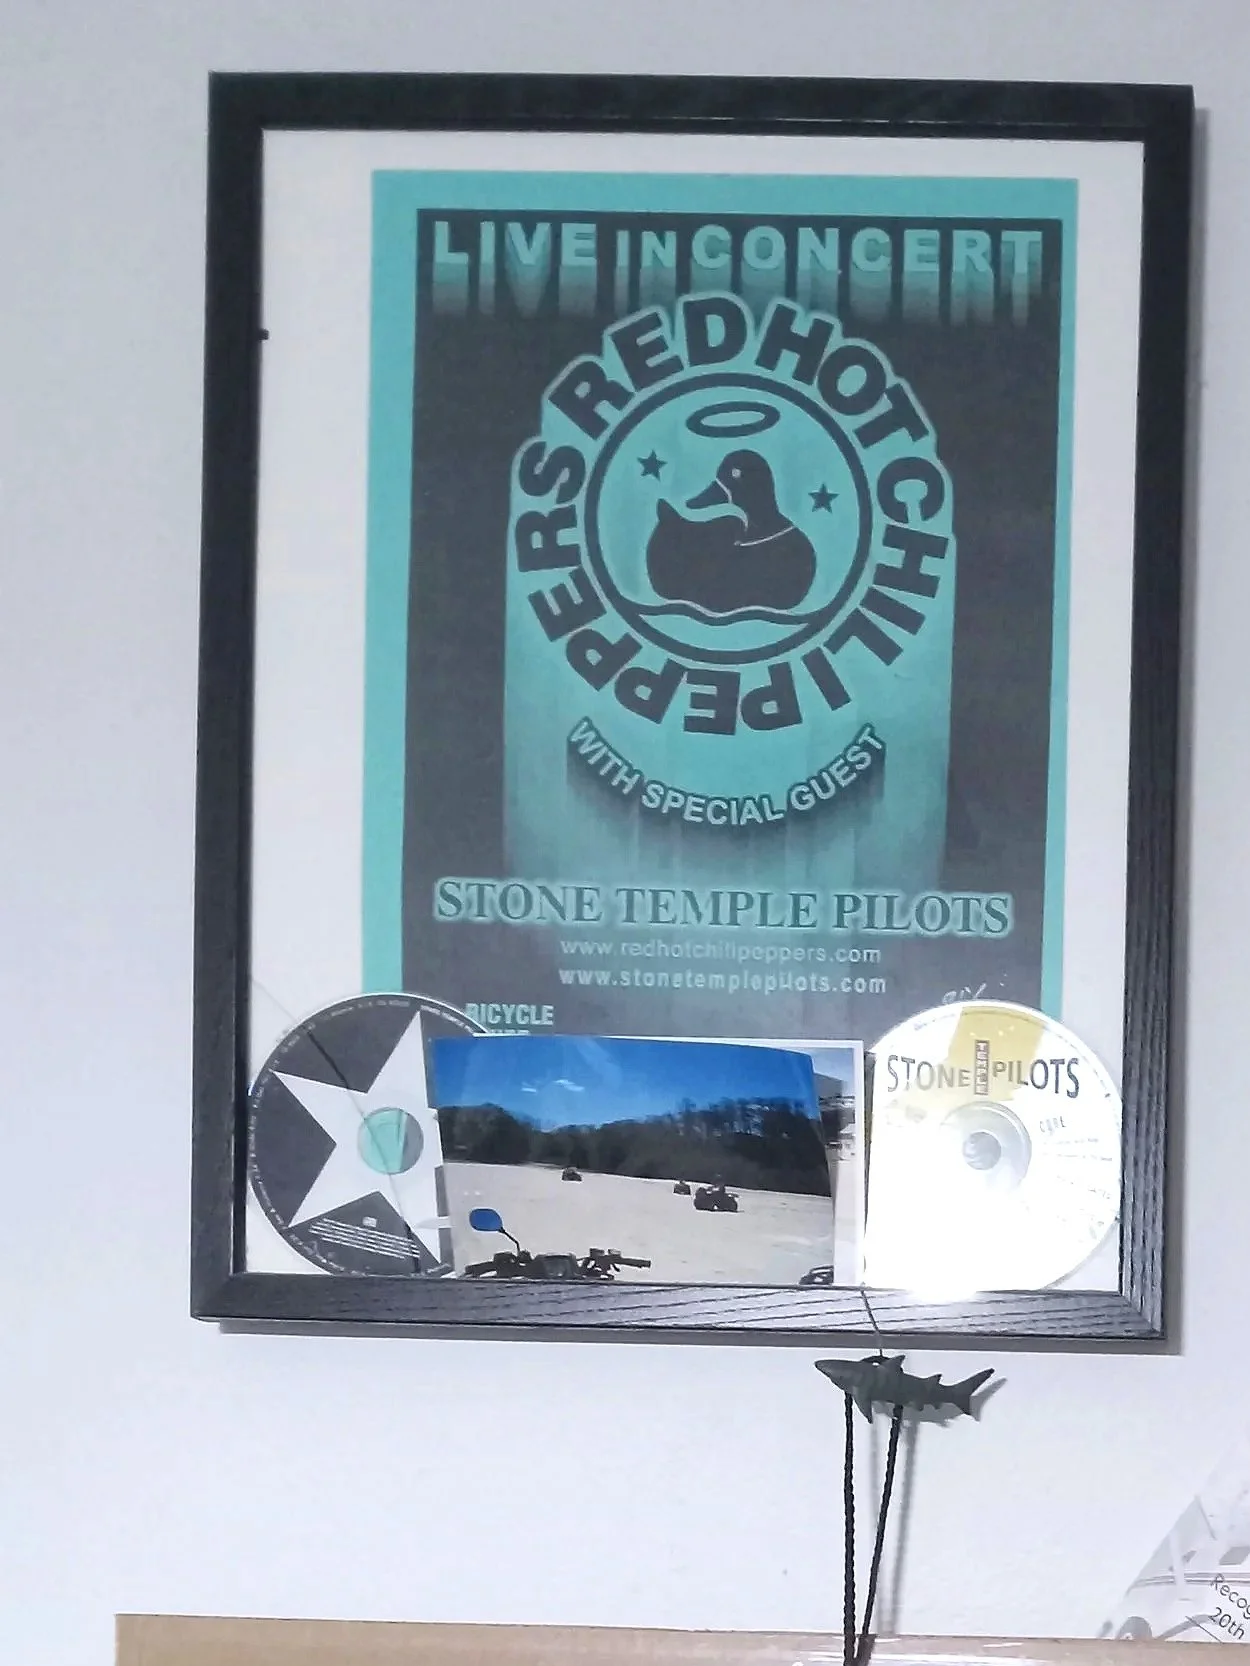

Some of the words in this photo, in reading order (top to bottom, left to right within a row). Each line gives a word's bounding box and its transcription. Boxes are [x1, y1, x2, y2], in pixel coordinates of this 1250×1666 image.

[433, 220, 598, 268] LIVE
[615, 229, 677, 269] IN
[691, 224, 1043, 273] CONCERT
[547, 297, 748, 440] RED
[755, 301, 930, 449] HOT
[514, 441, 803, 736] PEPPERS
[800, 456, 949, 712] CHILI
[569, 721, 640, 795] WITH
[641, 783, 784, 826] SPECIAL
[790, 726, 883, 811] GUEST
[435, 879, 603, 924] STONE
[615, 887, 819, 931] TEMPLE
[832, 894, 1011, 936] PILOTS
[558, 968, 886, 994] www.stonetemplepilots.com
[466, 1003, 554, 1025] BICYCLE
[887, 1054, 970, 1093] STONE
[992, 1058, 1080, 1098] PILOTS
[1208, 1607, 1246, 1640] 20th
